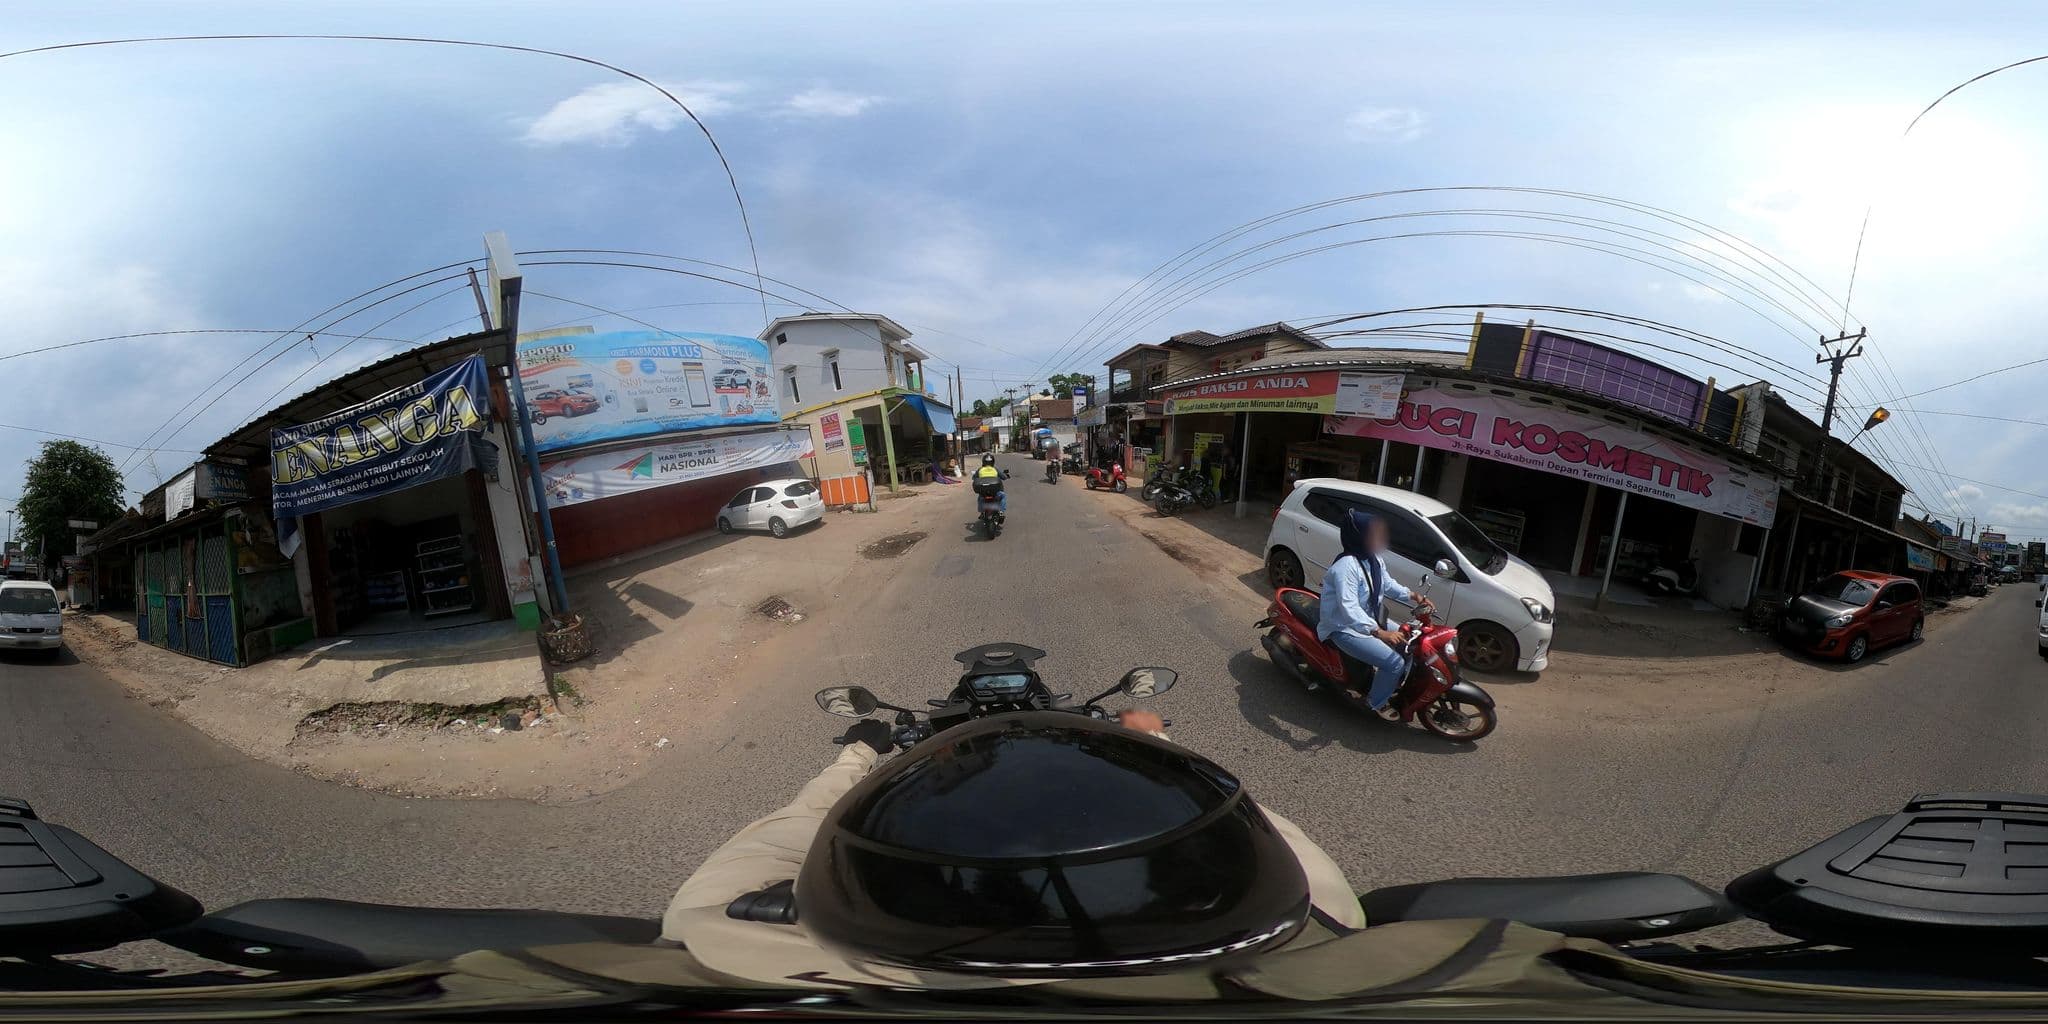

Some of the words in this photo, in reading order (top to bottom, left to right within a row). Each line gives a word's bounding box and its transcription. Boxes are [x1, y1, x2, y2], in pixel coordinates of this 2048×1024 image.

[671, 345, 702, 358] PLUS
[1200, 381, 1248, 395] BAKSO
[1253, 376, 1309, 390] ANDA
[1237, 400, 1249, 408] dan
[1249, 399, 1285, 408] Minuman
[272, 384, 482, 486] ENANGA
[274, 430, 300, 446] TOKO
[327, 473, 362, 489] SERAGAM
[363, 461, 399, 478] ATRIBUT
[400, 447, 444, 466] SEKOLAH
[660, 456, 719, 473] NASIONAL
[1466, 443, 1491, 456] Raya
[1494, 449, 1545, 468] Sukabumi
[1548, 460, 1579, 477] Depan
[1582, 469, 1624, 487] Terminal
[1625, 480, 1676, 500] Sagaranten
[1492, 415, 1714, 498] KOSMETIK
[297, 491, 337, 507] MENERIMA
[338, 481, 369, 496] BARANG
[370, 475, 390, 487] JADI
[390, 463, 431, 481] LAINNYA
